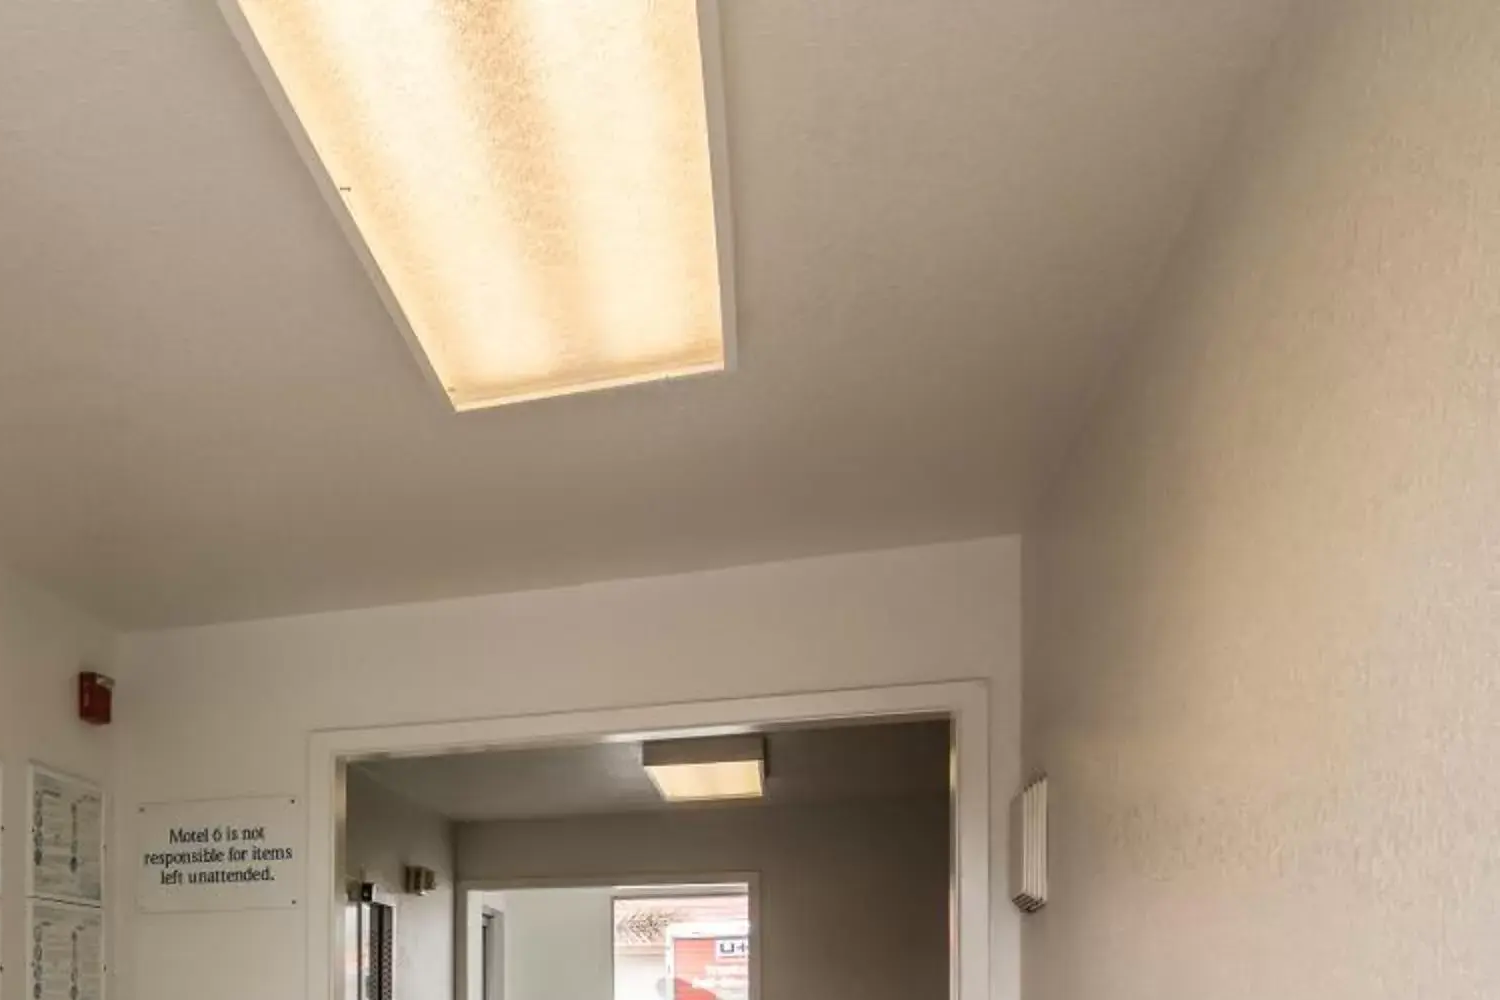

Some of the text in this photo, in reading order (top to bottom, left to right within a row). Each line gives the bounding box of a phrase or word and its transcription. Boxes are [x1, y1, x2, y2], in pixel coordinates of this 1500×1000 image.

[169, 826, 265, 844] Motel 6 is not
[144, 845, 293, 868] responsible for items
[160, 867, 276, 885] left unattended.
